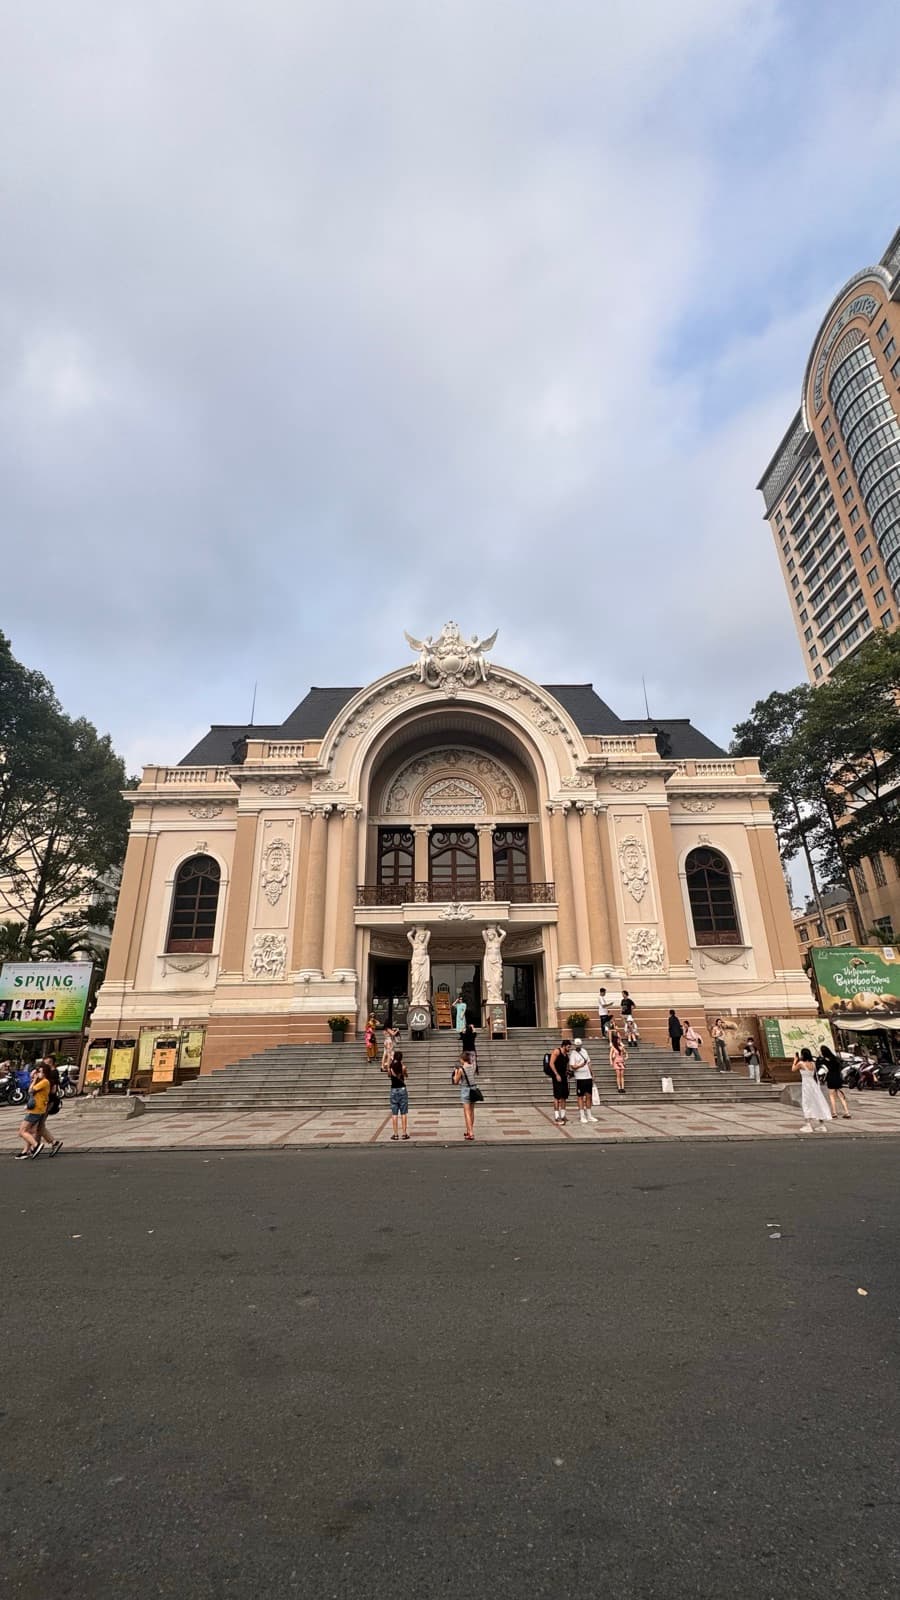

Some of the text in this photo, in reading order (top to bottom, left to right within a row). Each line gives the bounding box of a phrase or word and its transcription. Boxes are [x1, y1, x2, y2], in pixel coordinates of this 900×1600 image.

[849, 298, 876, 316] HOTEL
[14, 976, 73, 991] SPRING
[833, 973, 871, 986] Bamboo
